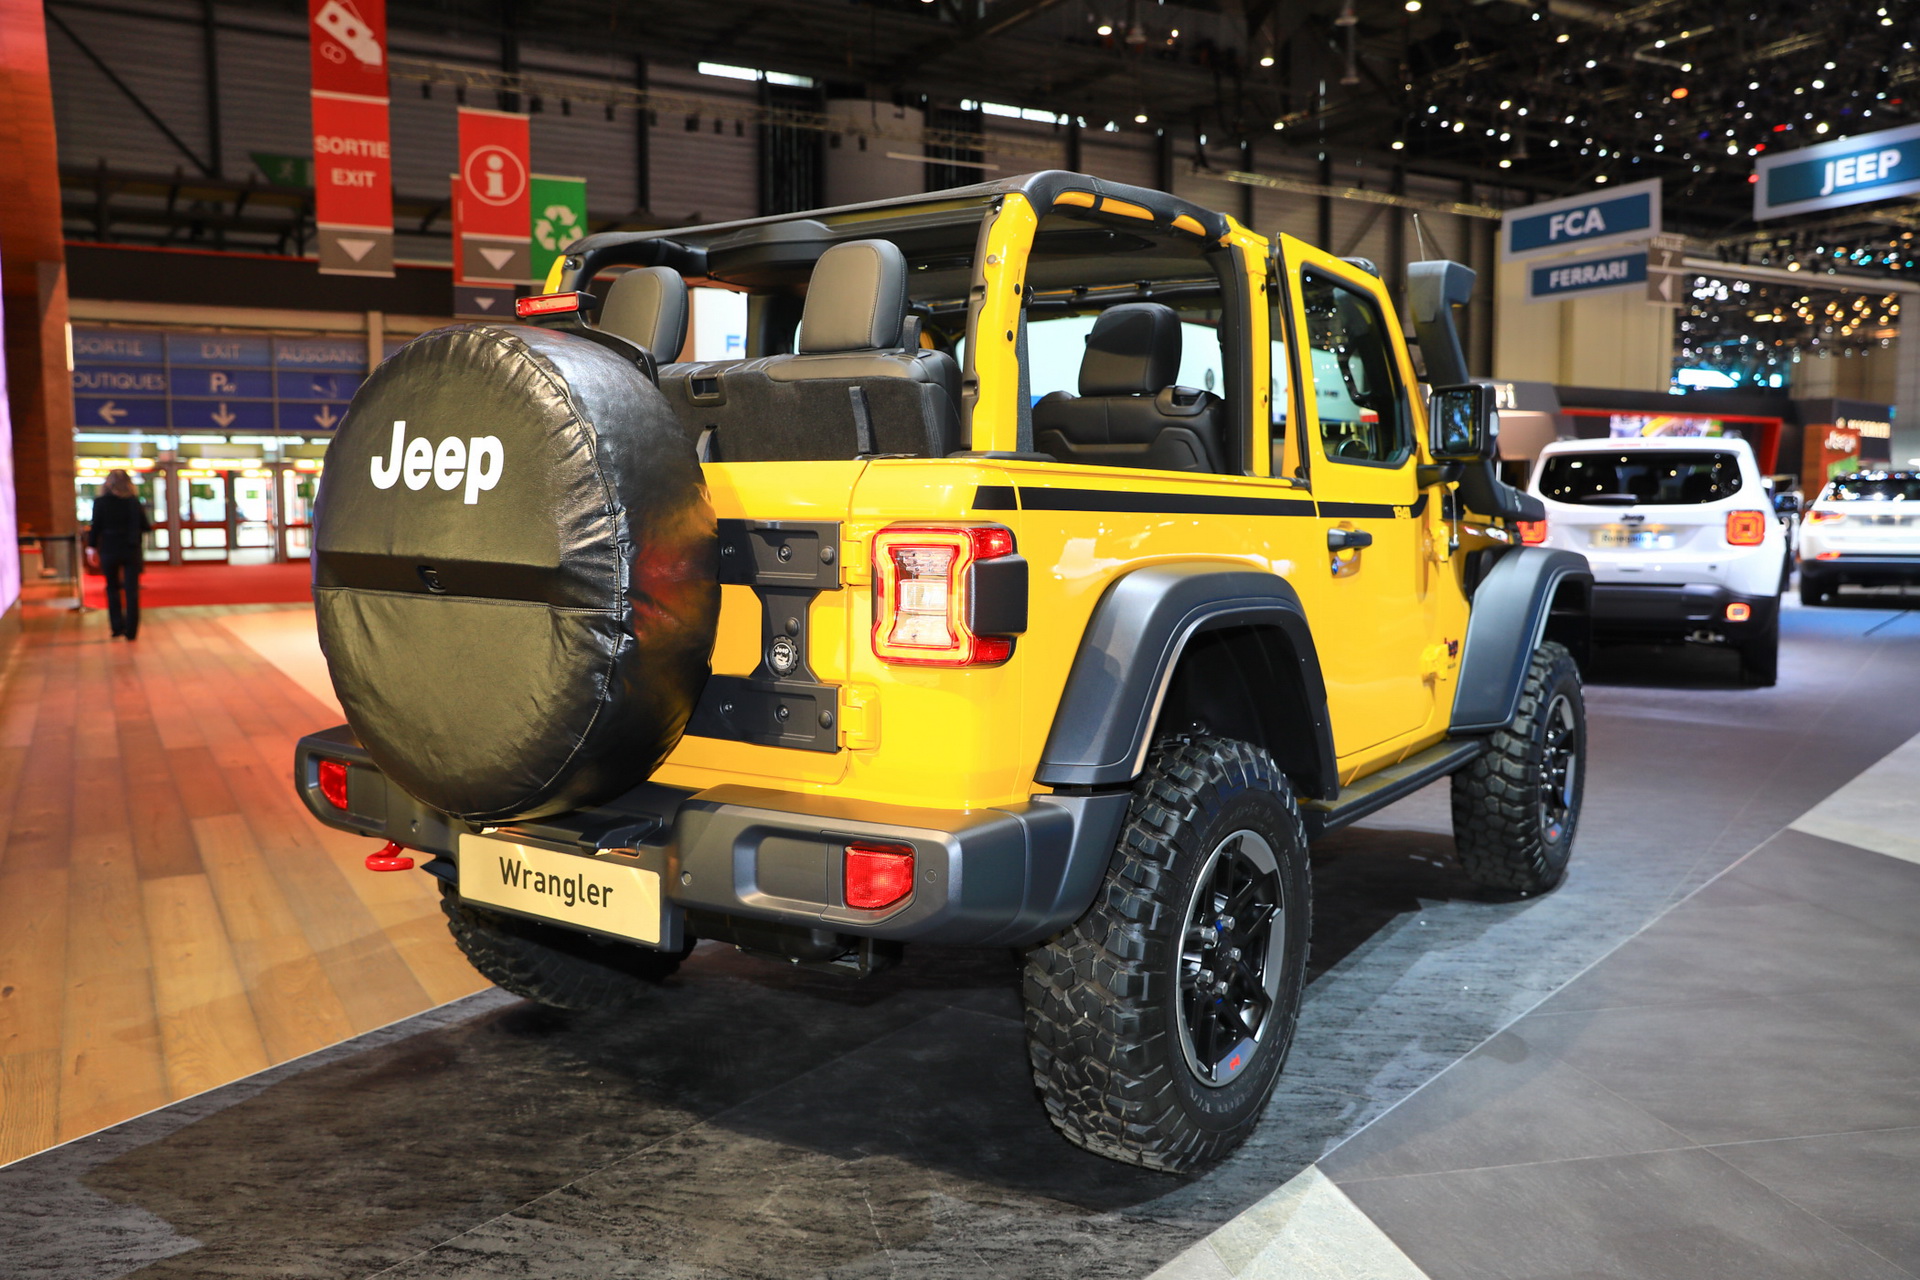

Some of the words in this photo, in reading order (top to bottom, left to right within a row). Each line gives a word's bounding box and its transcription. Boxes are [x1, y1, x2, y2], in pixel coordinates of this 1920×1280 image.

[315, 135, 390, 159] SORTIE
[331, 167, 376, 188] EXIT
[1820, 149, 1901, 196] JEEP
[1549, 207, 1606, 240] FCA
[1661, 251, 1672, 268] 7
[1549, 259, 1629, 288] FERRARI
[74, 338, 145, 357] SORTIE
[200, 344, 240, 359] EXIT
[726, 335, 747, 353] F
[73, 372, 167, 390] OUTIQUES
[370, 420, 505, 505] Jeep
[499, 856, 614, 908] Wrangler
